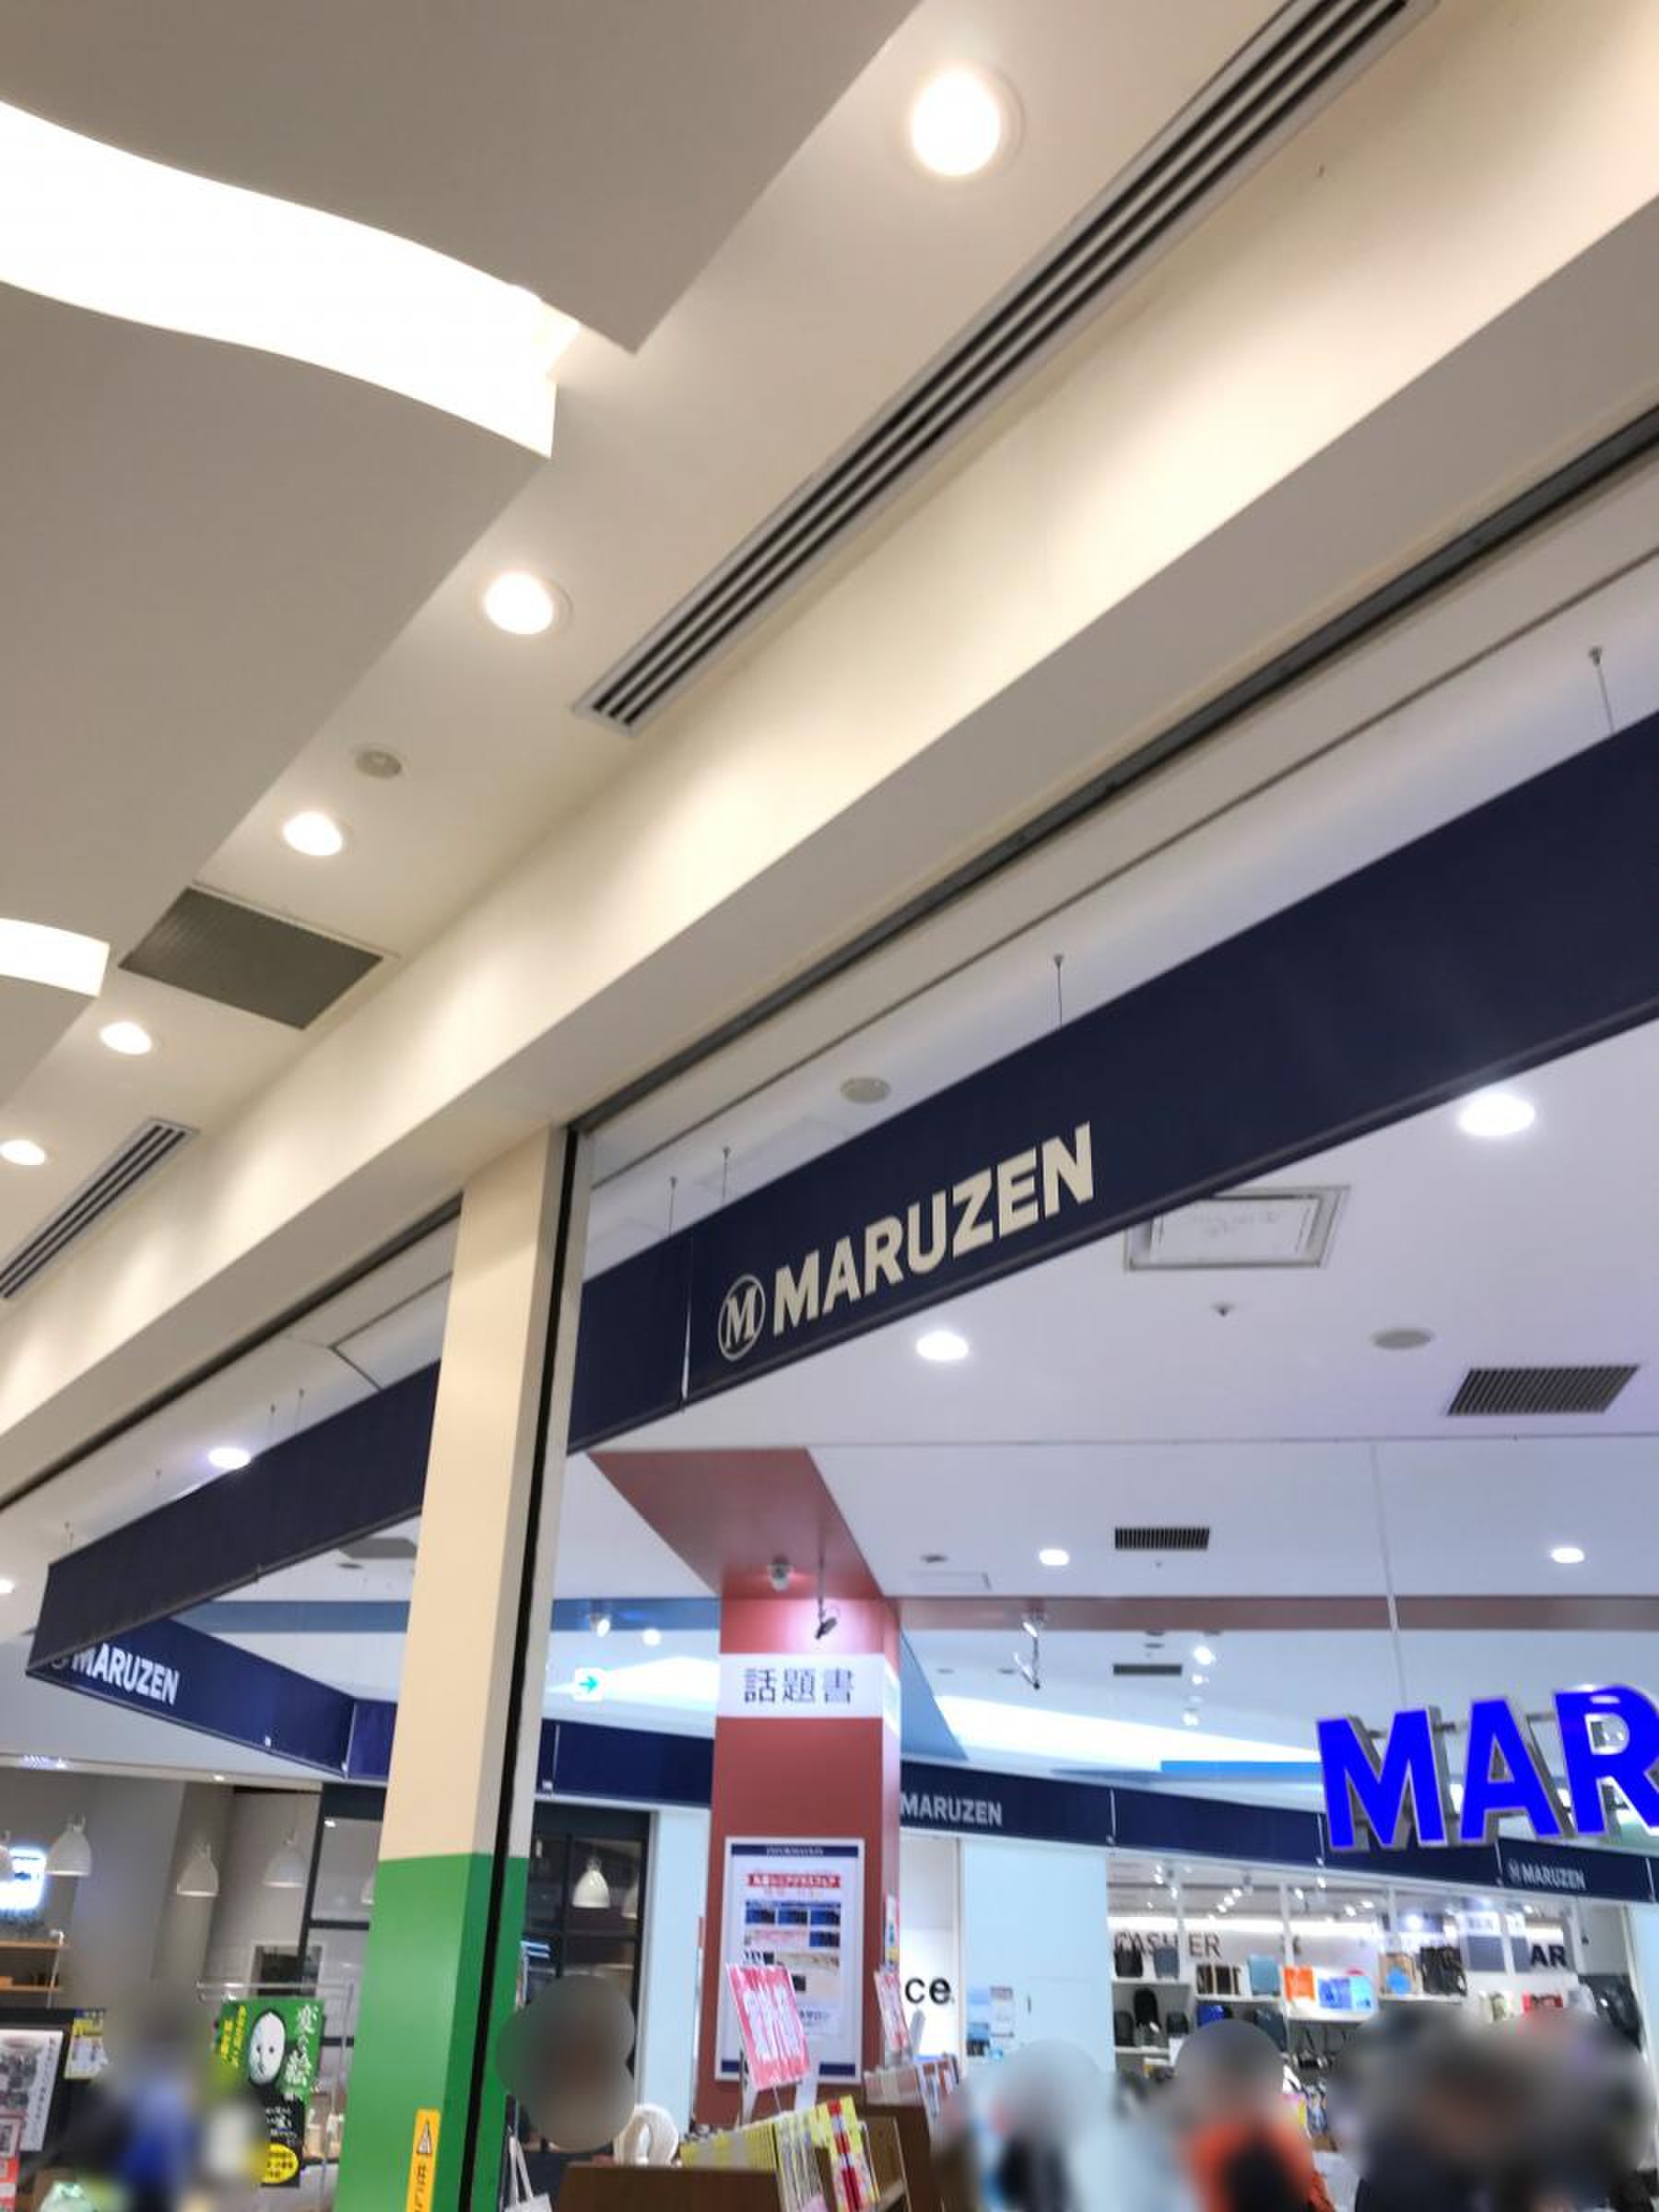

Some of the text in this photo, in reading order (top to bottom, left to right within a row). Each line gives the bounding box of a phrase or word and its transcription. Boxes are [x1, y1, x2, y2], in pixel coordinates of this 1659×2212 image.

[773, 1121, 1094, 1335] MARUZEN
[744, 1667, 853, 1703] 話題書
[1316, 1684, 1659, 1851] MAR
[900, 1793, 1003, 1827] MARUZEN
[1521, 1863, 1586, 1890] MARUZEN
[1114, 1932, 1222, 1959] CASHER
